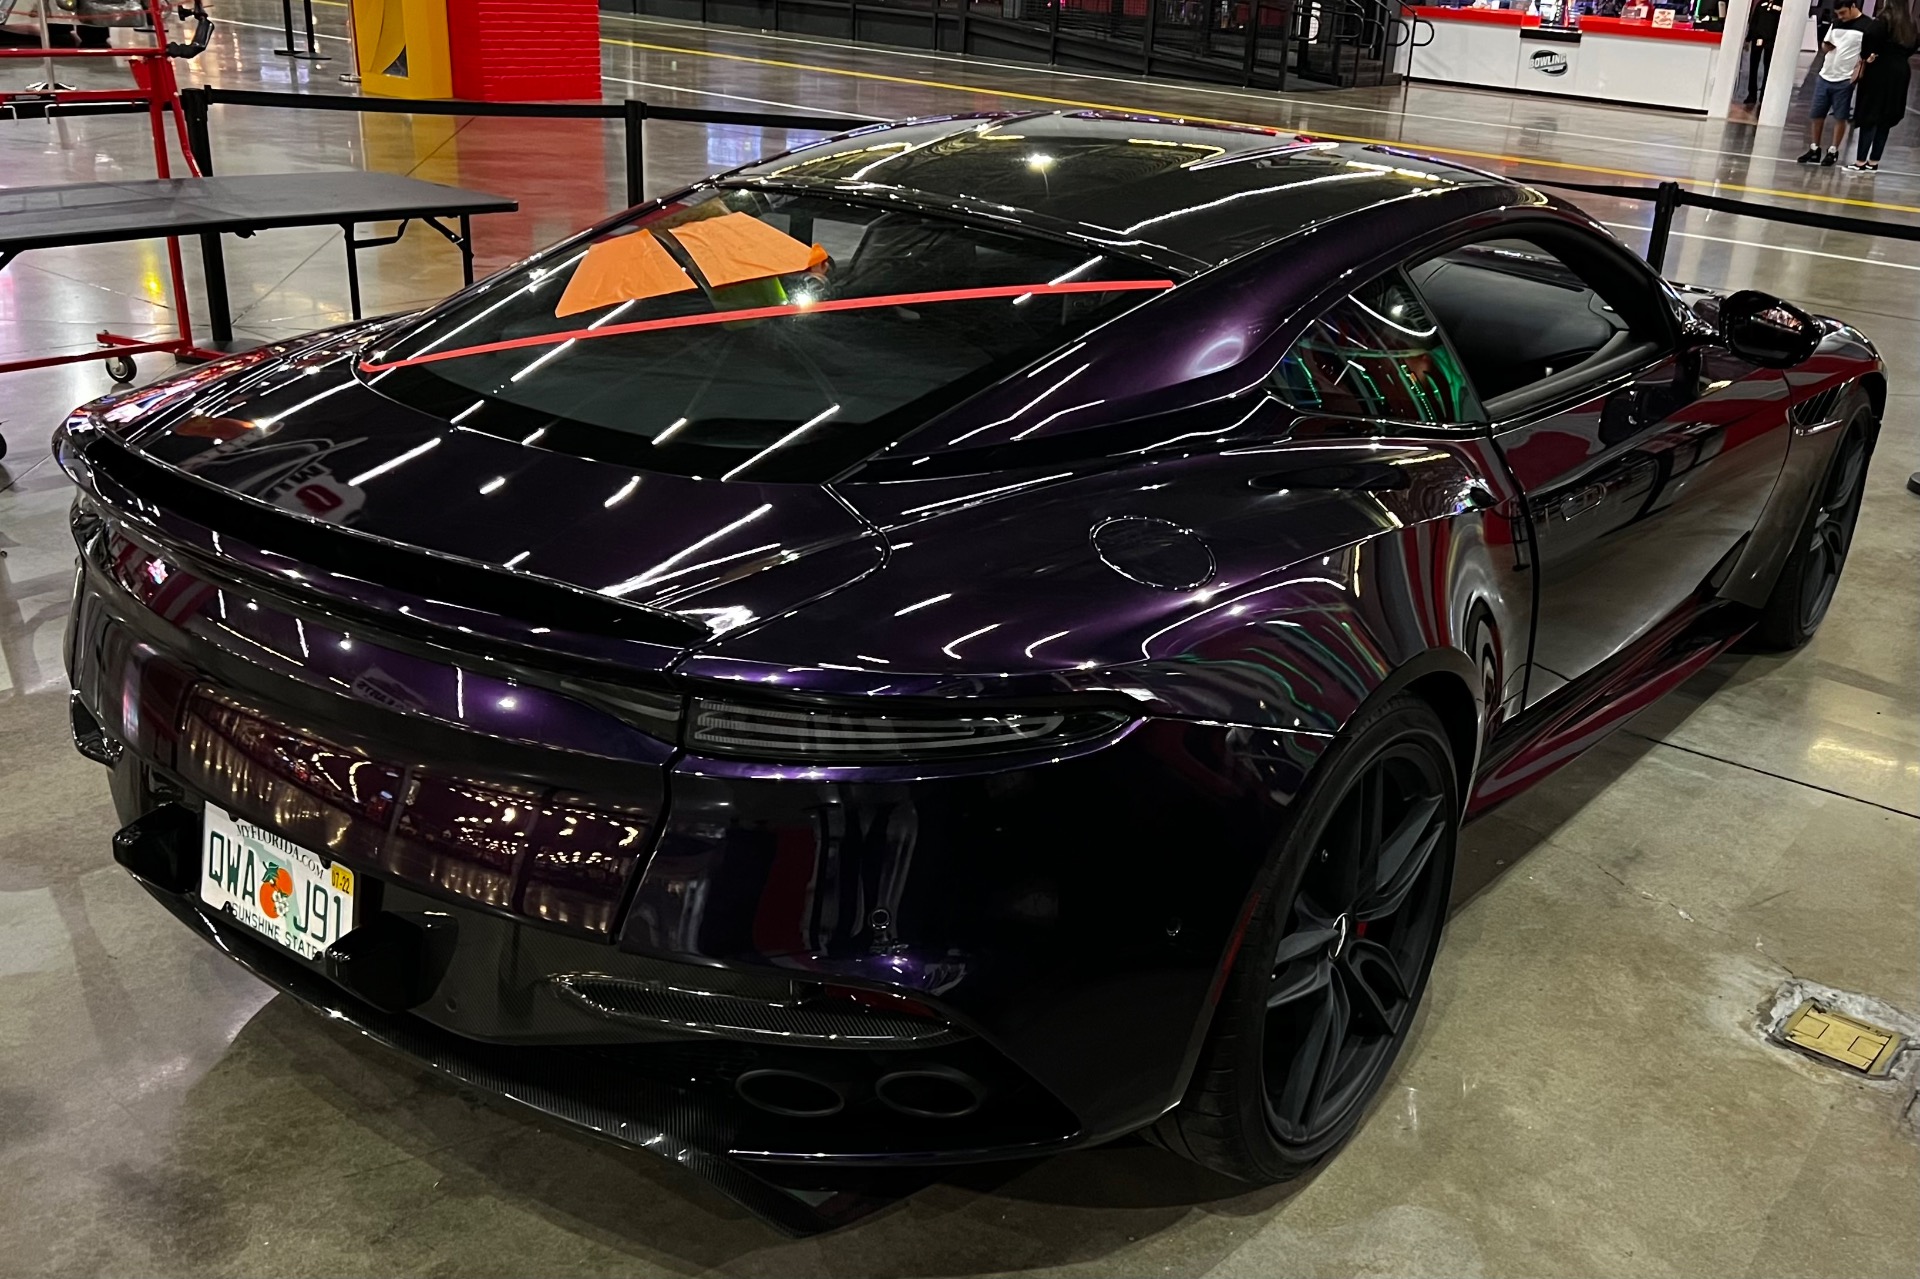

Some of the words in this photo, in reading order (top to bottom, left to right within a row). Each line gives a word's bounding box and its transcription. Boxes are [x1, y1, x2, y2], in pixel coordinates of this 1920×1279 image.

[1529, 53, 1567, 68] BOWLING
[237, 824, 324, 880] MYFLORIDA.COM
[209, 830, 256, 907] QWA
[293, 879, 342, 943] J91
[231, 902, 281, 941] SUNSHINE
